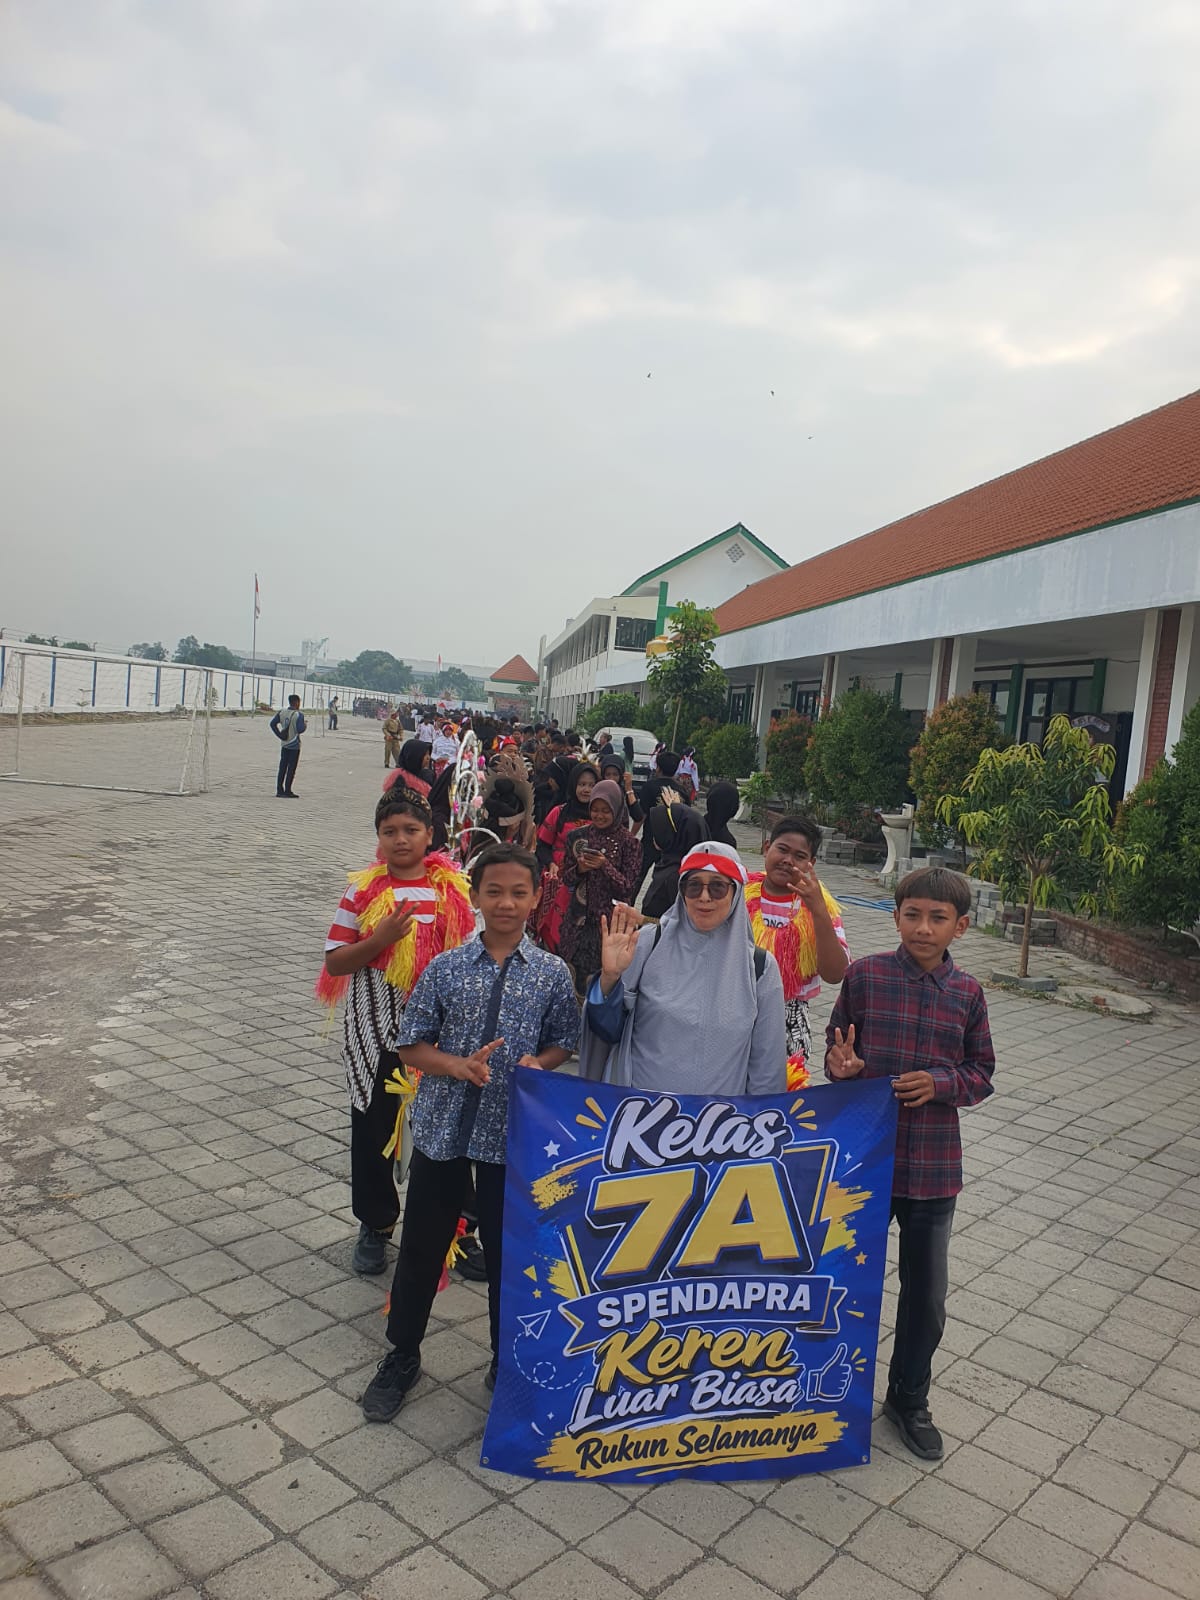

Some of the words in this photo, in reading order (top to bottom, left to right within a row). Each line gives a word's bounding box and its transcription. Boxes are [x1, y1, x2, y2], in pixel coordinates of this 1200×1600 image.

[607, 1096, 788, 1169] Kelas
[593, 1162, 801, 1277] 7A
[597, 1281, 811, 1328] SPENDAPRA
[596, 1320, 794, 1393] Keren
[567, 1382, 678, 1434] Luar
[690, 1369, 803, 1411] Biasa
[576, 1434, 669, 1470] Rukun
[675, 1421, 819, 1458] Selamanya
